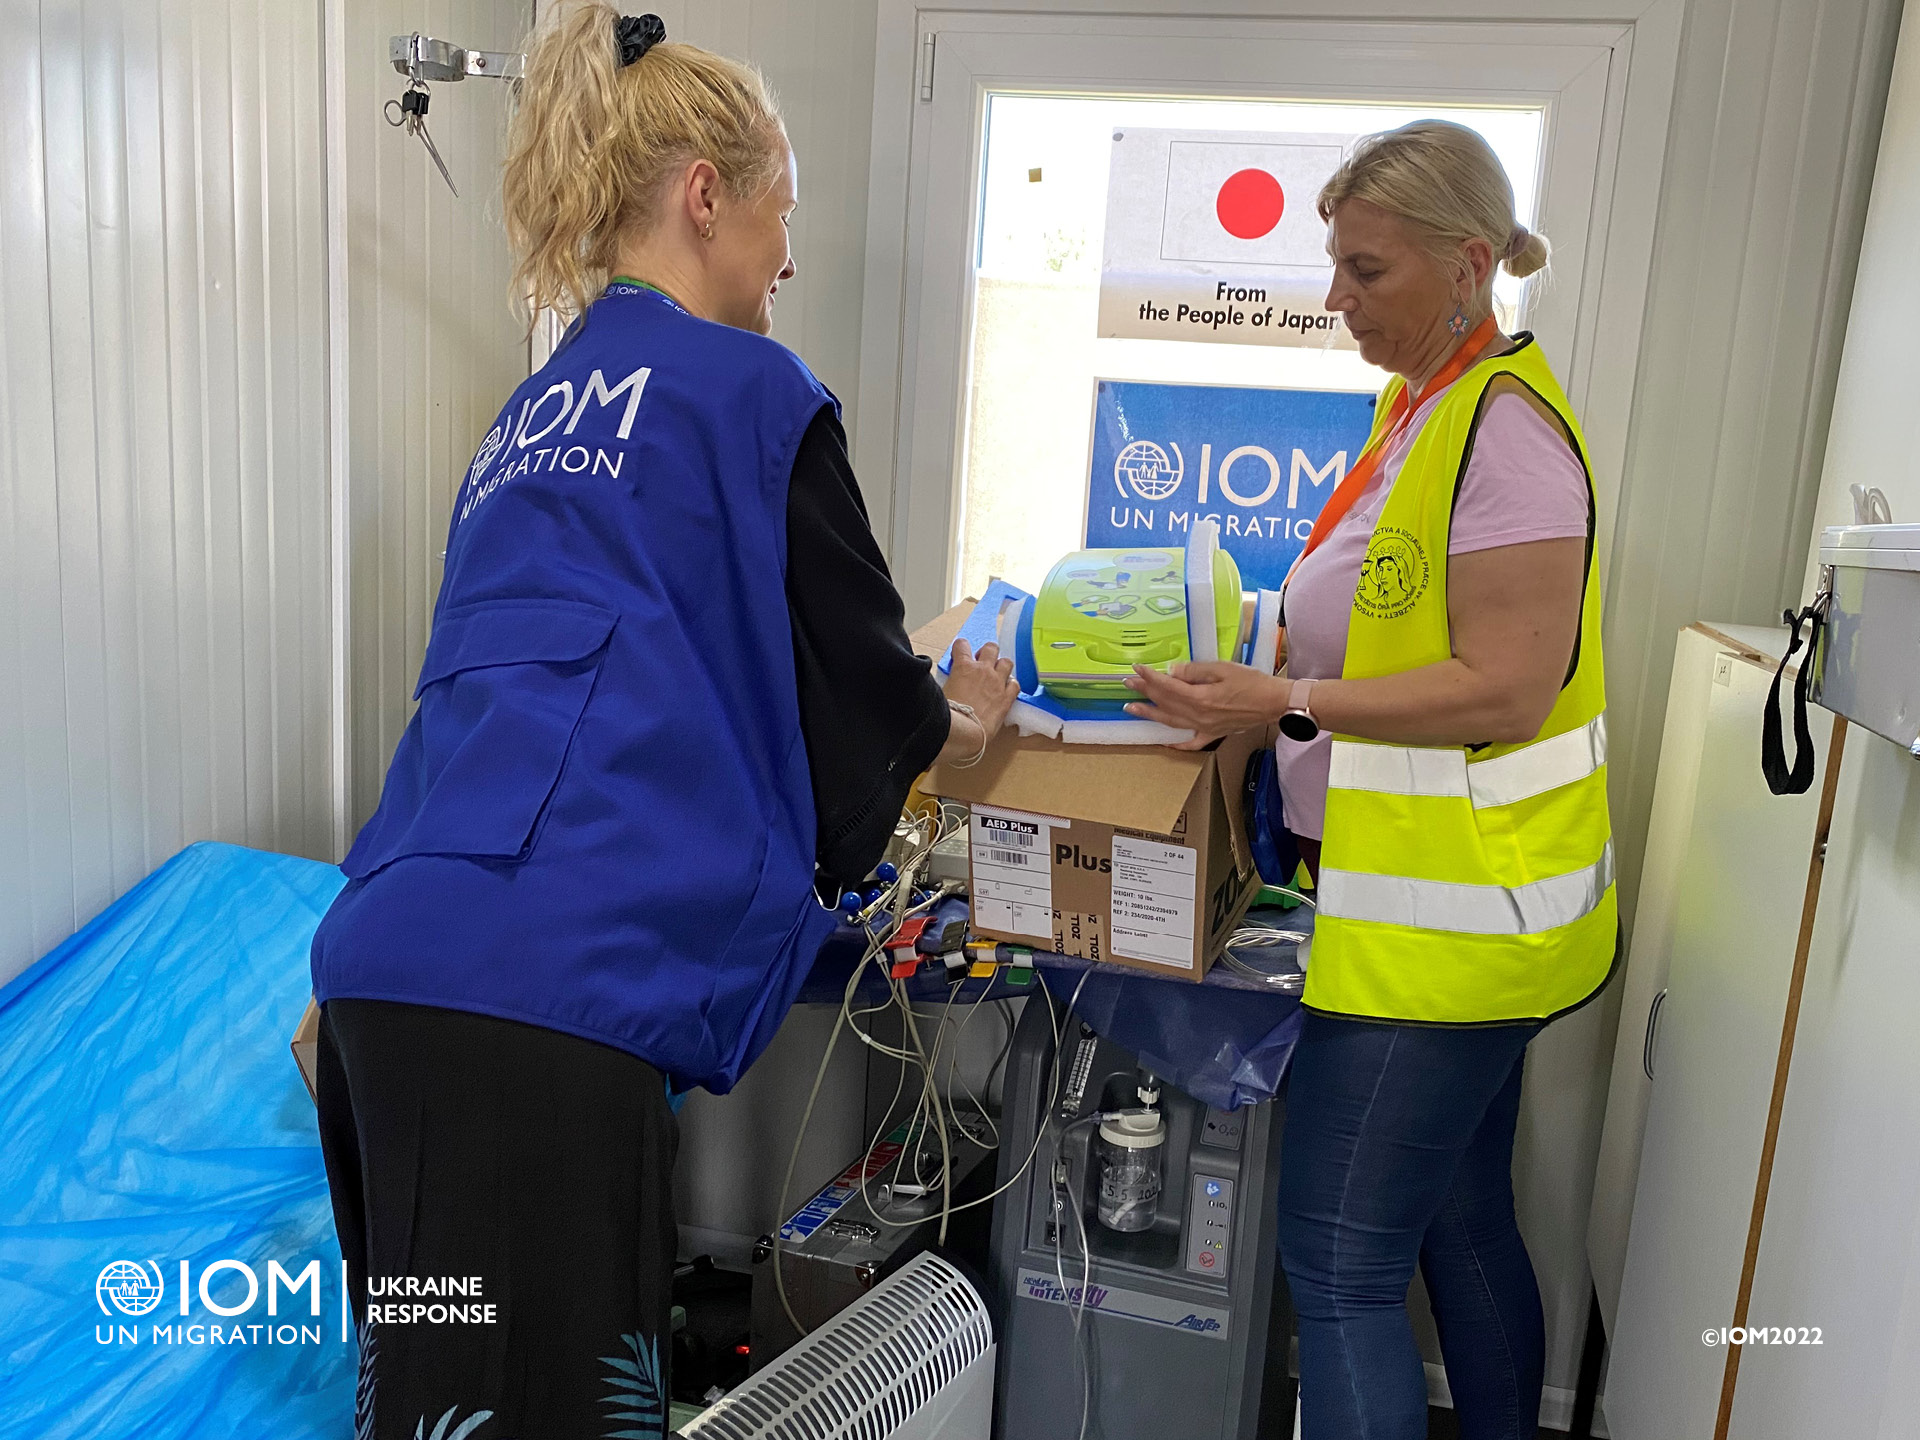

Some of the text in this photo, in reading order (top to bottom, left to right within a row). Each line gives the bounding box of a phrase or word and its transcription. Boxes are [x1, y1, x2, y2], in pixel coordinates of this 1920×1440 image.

[617, 286, 638, 295] IOM
[1216, 282, 1267, 302] From
[1139, 301, 1169, 321] the
[1177, 304, 1244, 330] People
[1251, 307, 1273, 326] of
[500, 367, 652, 464] IOM
[472, 446, 624, 511] MIGRATION
[1197, 443, 1347, 509] IOM
[1111, 506, 1154, 530] UN
[986, 819, 1032, 833] AED Plus
[1056, 844, 1112, 874] Plus
[1114, 890, 1136, 898] WEIGHT:
[1071, 914, 1080, 940] ZOLL
[1090, 934, 1099, 960] ZOLL
